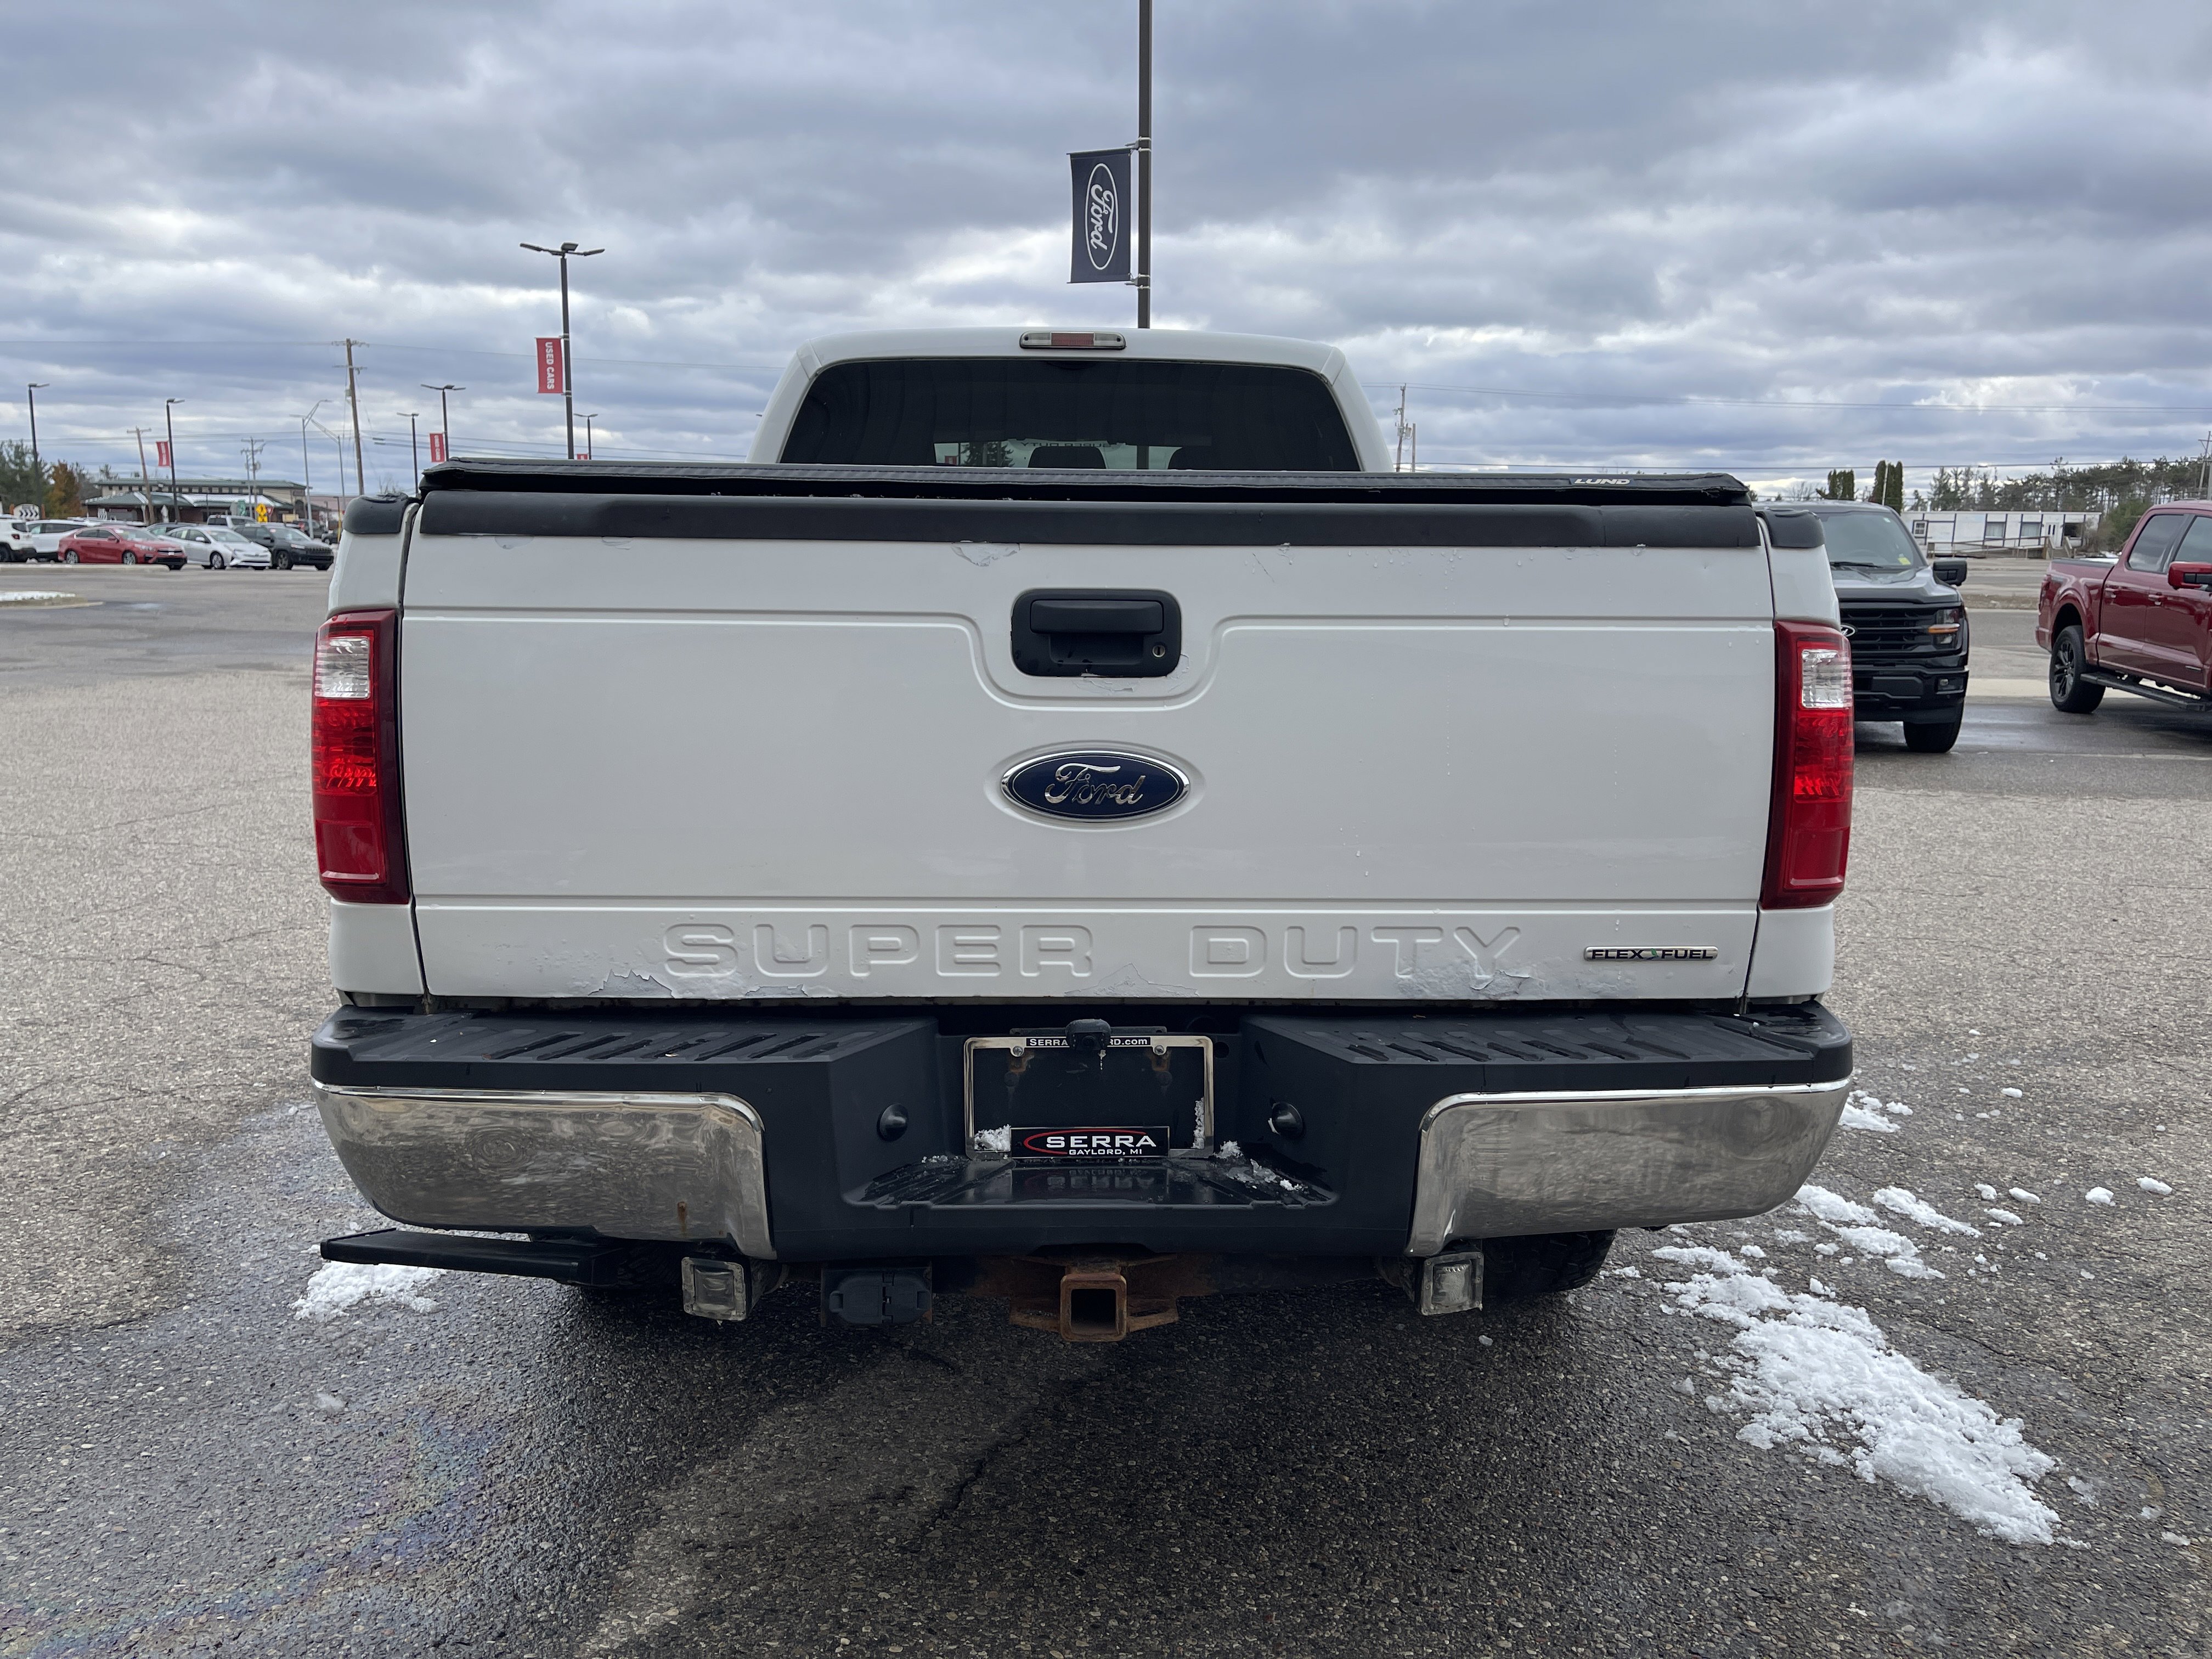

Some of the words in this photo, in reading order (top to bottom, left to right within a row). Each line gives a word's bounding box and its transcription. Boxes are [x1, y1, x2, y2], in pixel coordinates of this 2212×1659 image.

[1091, 184, 1114, 250] Ford
[545, 342, 554, 365] USED
[546, 366, 555, 390] CARS
[1045, 763, 1146, 804] Ford
[662, 923, 1095, 978] SUPER
[1189, 926, 1521, 978] DUTY
[1592, 950, 1644, 960] FLEX
[1661, 950, 1713, 959] FUEL
[1046, 1136, 1156, 1148] SERRA
